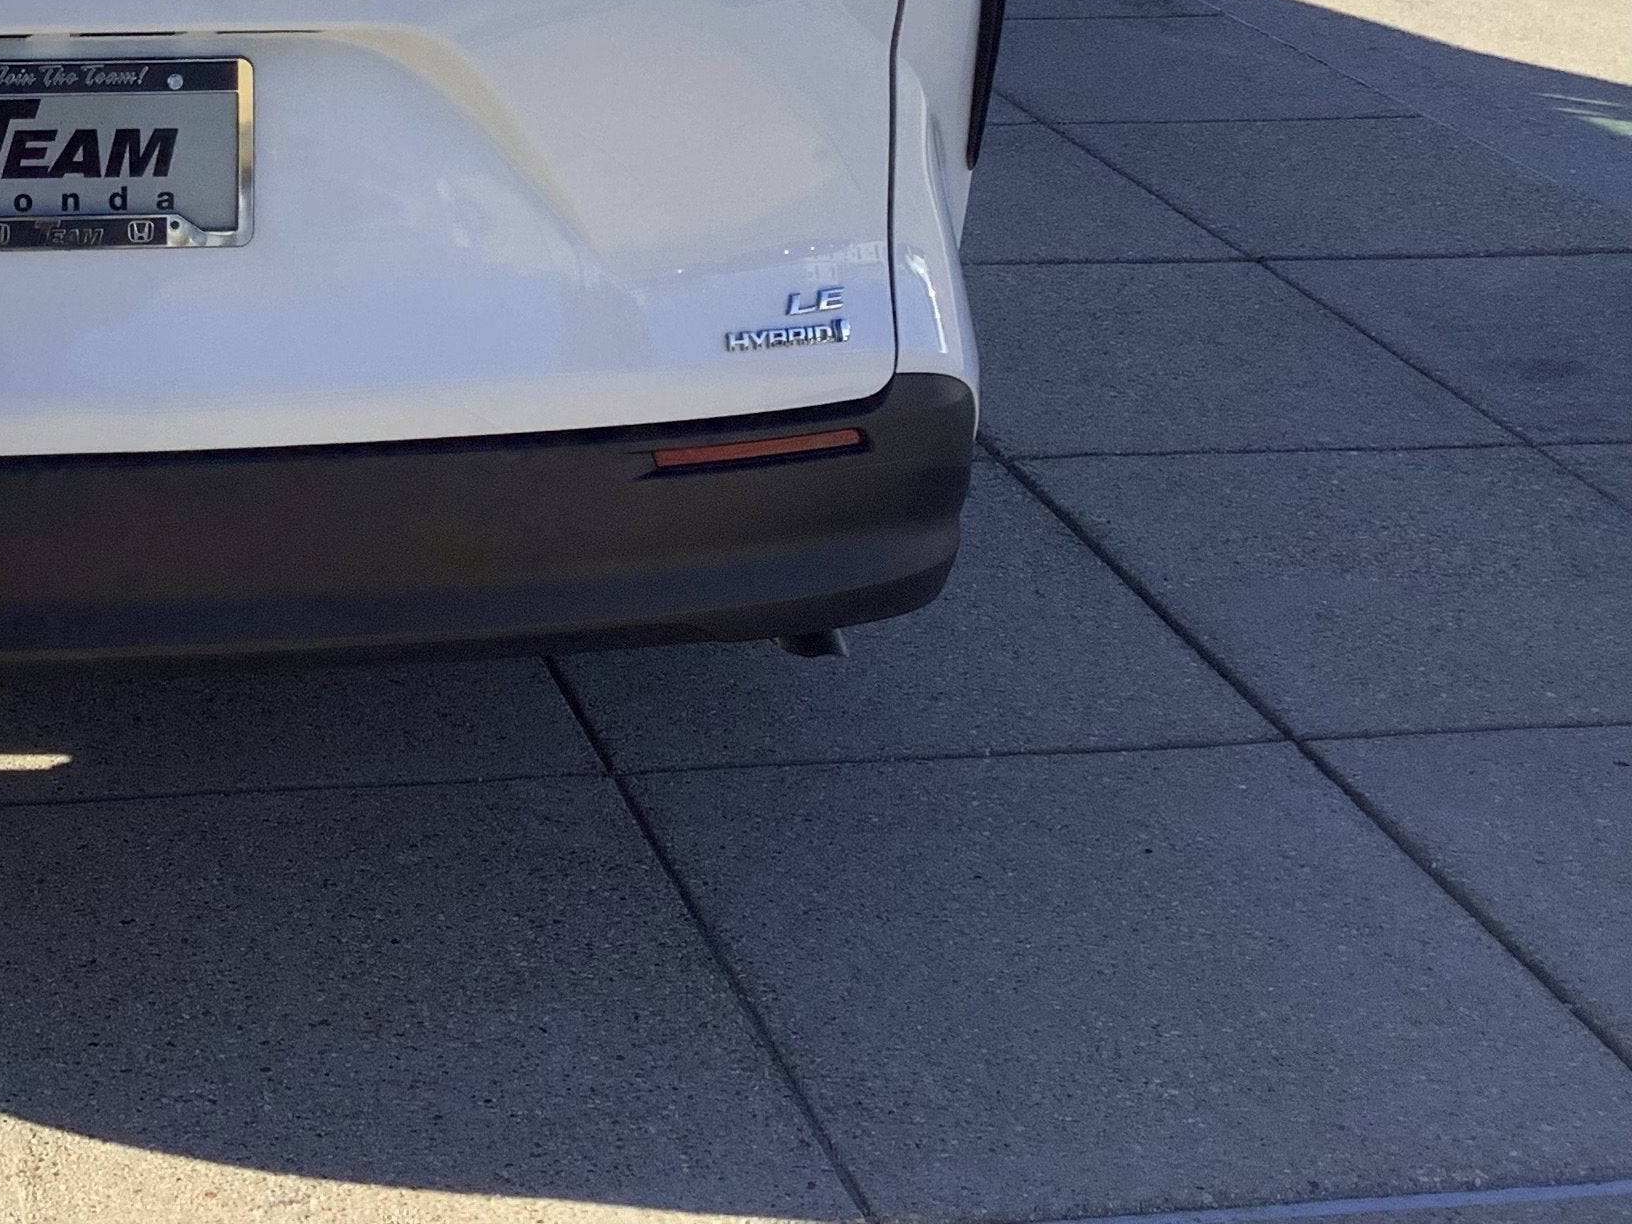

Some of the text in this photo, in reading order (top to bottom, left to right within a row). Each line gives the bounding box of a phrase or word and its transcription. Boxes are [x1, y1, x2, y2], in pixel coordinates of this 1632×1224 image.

[37, 64, 79, 87] The
[79, 64, 149, 86] Team!
[785, 286, 846, 316] LE
[725, 324, 833, 352] HYBRID
